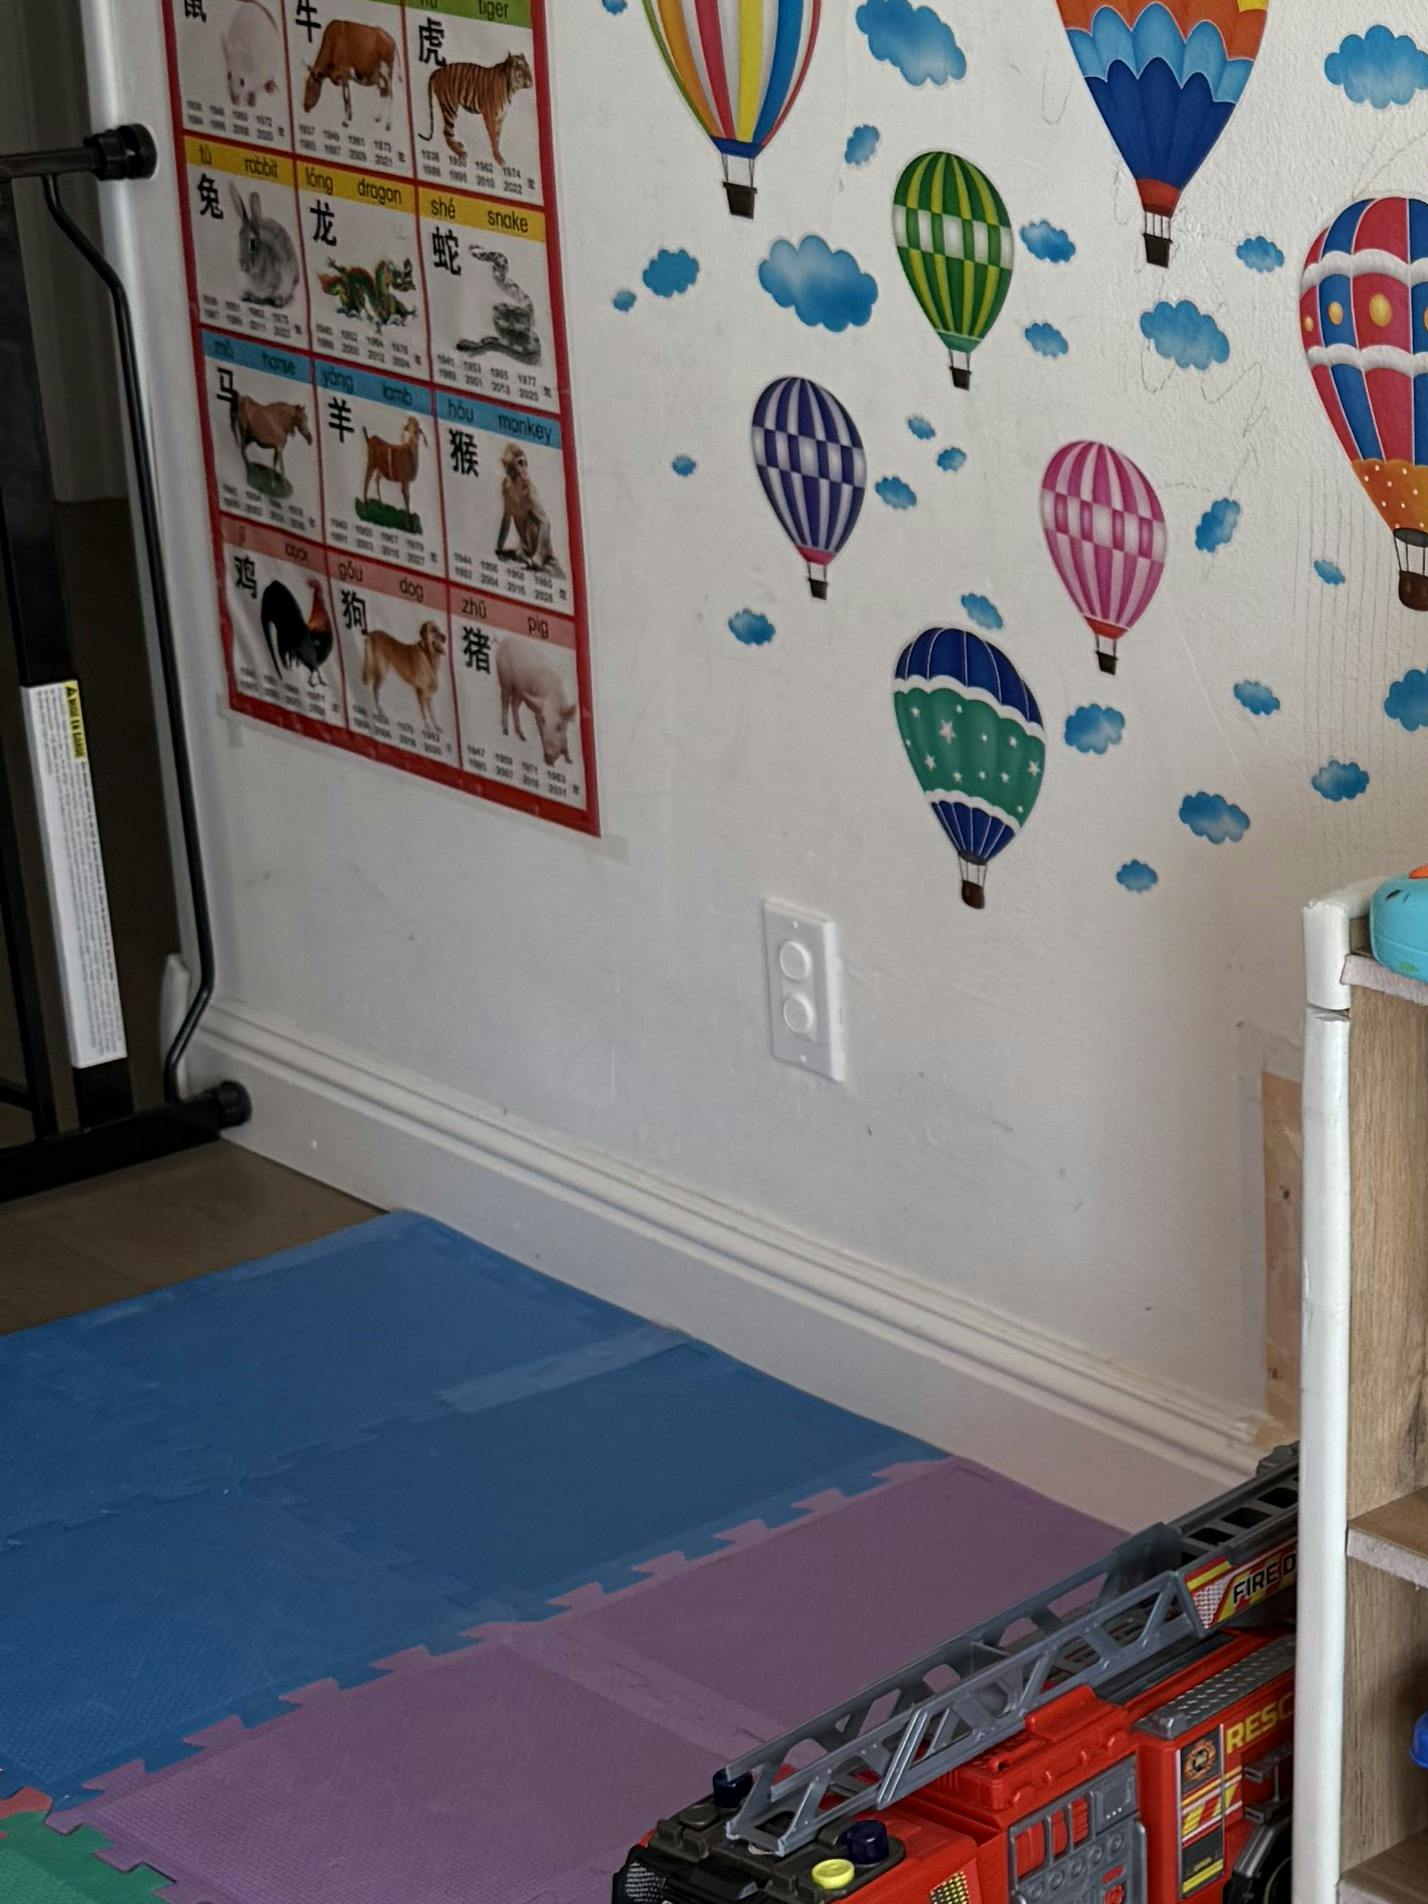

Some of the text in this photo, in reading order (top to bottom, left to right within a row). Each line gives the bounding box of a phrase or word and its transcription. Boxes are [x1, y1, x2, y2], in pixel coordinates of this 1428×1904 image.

[418, 17, 446, 67] 虎
[244, 157, 279, 179] rabbit
[197, 173, 224, 221] 兔
[357, 179, 402, 205] dragon
[310, 199, 338, 247] 龙
[431, 196, 529, 233] shé snake
[432, 226, 462, 276] 蛇
[216, 367, 240, 406] 马
[382, 382, 413, 406] lamb
[328, 397, 354, 443] 羊
[498, 414, 552, 446] monkey
[449, 428, 480, 478] 猴
[233, 555, 258, 600] 鸡
[399, 577, 425, 604] dog
[341, 590, 369, 636] 狗
[527, 616, 550, 641] pig
[462, 626, 491, 675] 猪
[1233, 1561, 1279, 1604] FIRE
